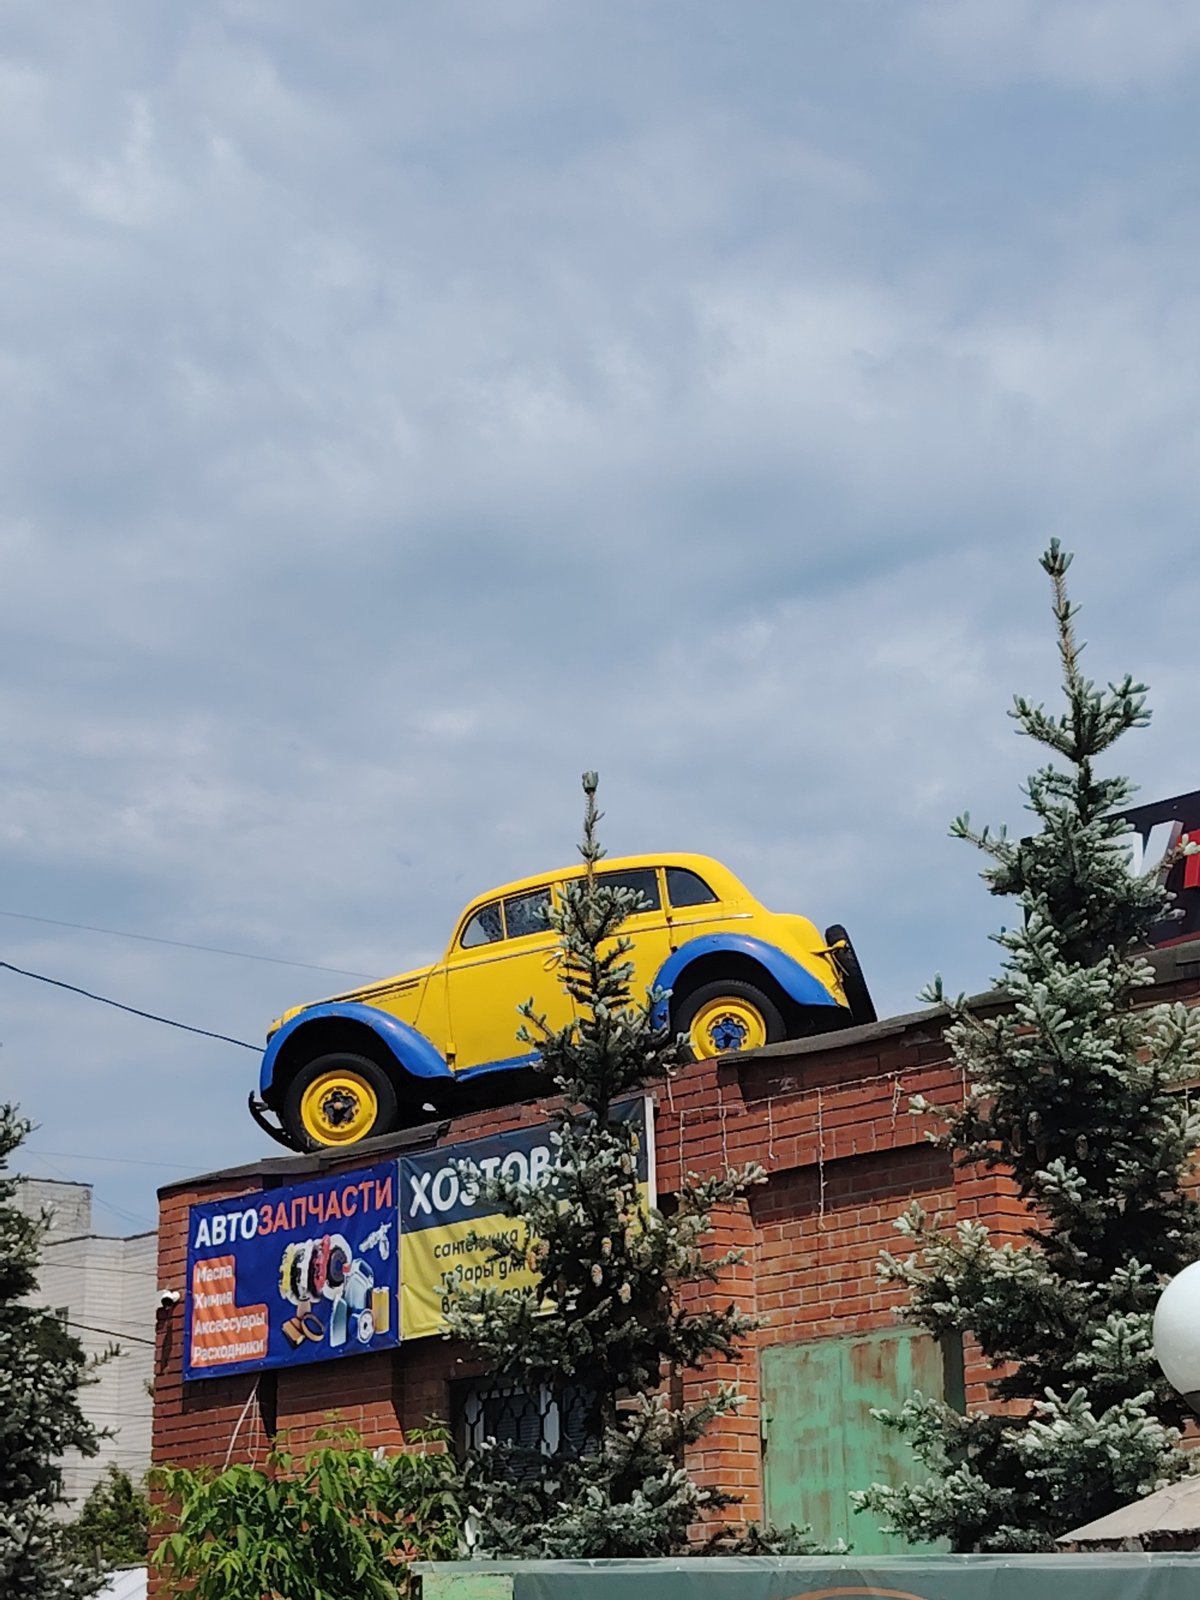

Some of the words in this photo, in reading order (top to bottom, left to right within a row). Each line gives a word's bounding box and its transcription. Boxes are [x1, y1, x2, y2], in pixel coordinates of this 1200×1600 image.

[195, 1176, 392, 1249] АВТОЗАПЧАСТИ
[197, 1265, 232, 1283] Масла
[194, 1291, 232, 1308] Химия
[192, 1340, 263, 1362] Расходники
